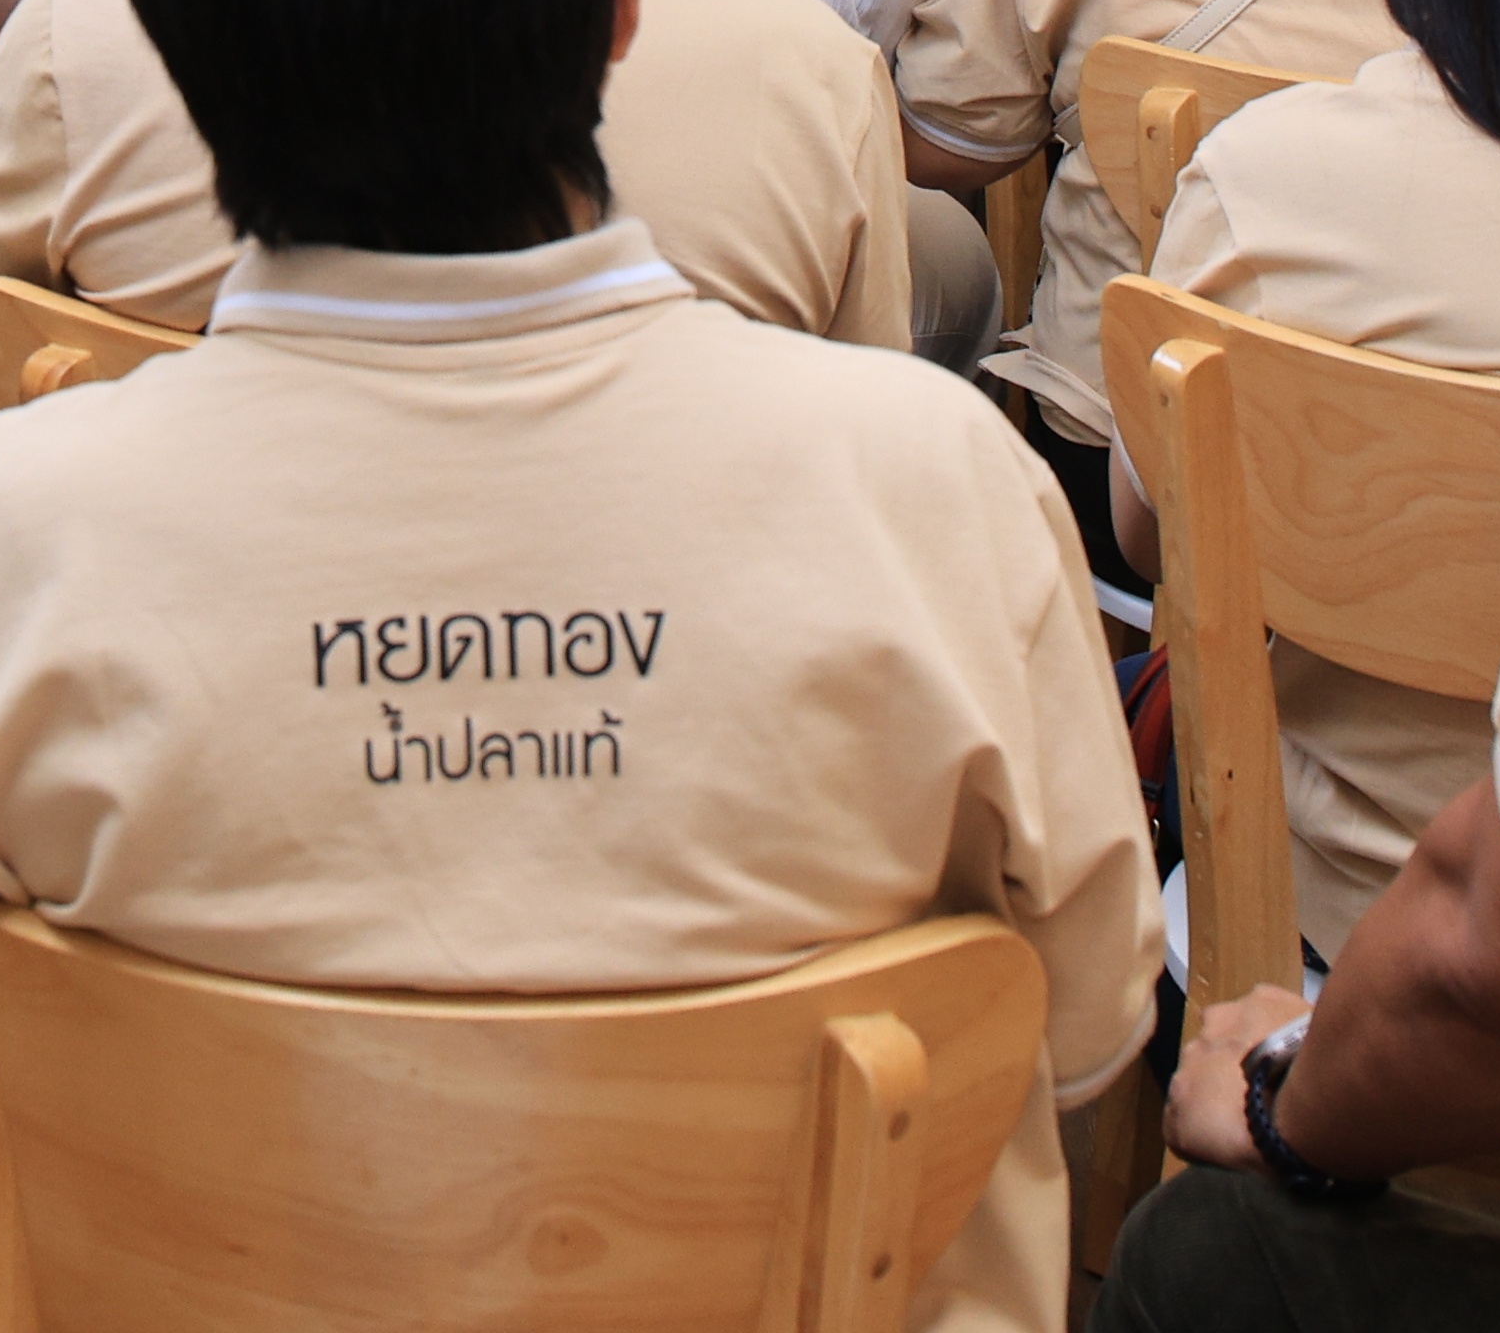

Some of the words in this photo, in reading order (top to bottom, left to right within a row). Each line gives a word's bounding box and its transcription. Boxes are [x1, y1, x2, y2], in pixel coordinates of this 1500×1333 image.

[310, 608, 665, 688] หยดทอง
[363, 702, 624, 787] น้ำปลาแท้
